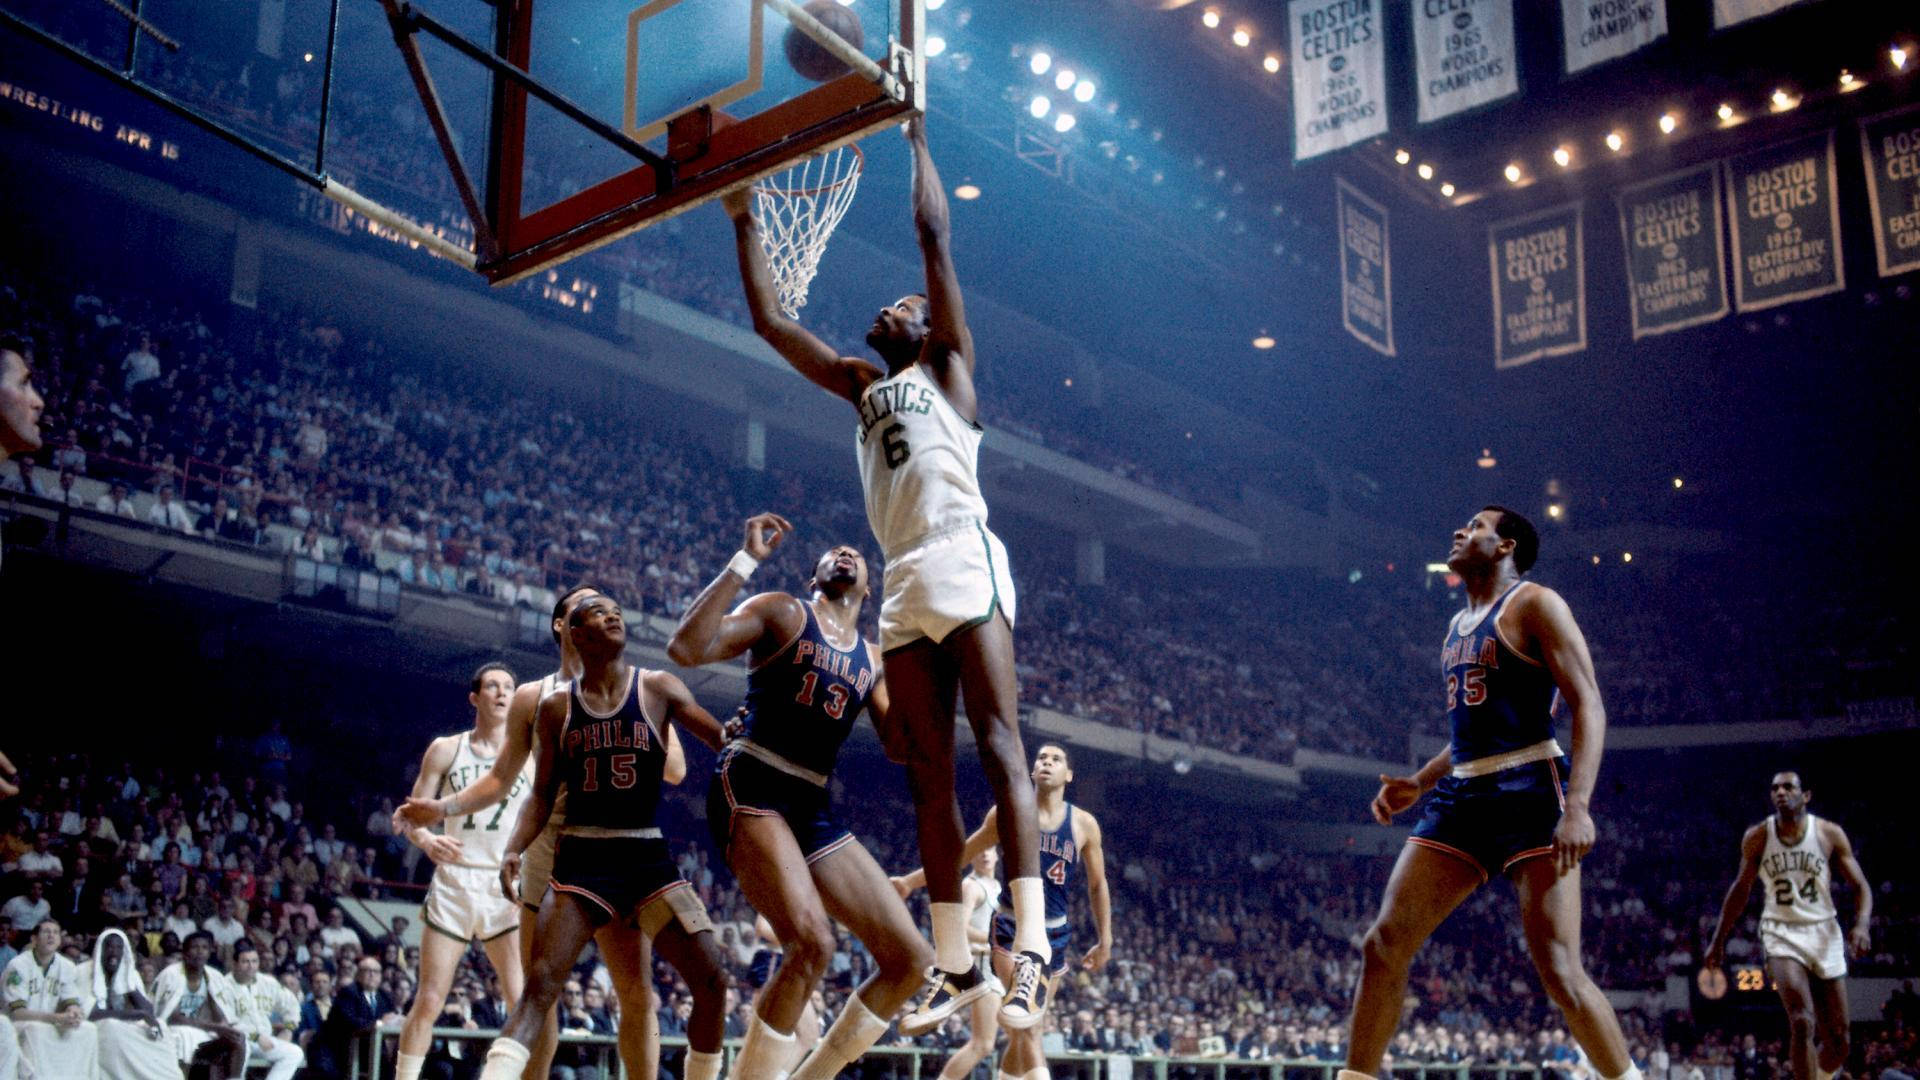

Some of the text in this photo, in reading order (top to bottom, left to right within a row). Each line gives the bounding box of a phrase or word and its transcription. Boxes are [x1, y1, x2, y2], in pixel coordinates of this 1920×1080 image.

[1303, 17, 1372, 60] CELTICS
[1581, 1, 1655, 47] CHAMPIONS
[1429, 57, 1503, 97] CHAMPIONS
[1441, 46, 1489, 72] WORLD
[0, 81, 104, 132] WRESTLING
[116, 125, 151, 150] APR
[1307, 101, 1375, 137] CHAMPIONS
[1746, 157, 1816, 197] BOSTON
[1635, 191, 1700, 226] BOSTON
[1748, 180, 1818, 219] CELTICS
[1505, 227, 1567, 262] BOSTON
[1636, 212, 1700, 248] CELTICS
[1507, 249, 1568, 282] CELTICS
[1747, 245, 1801, 272] EASTERN
[1753, 256, 1822, 287] CHAMPIONS
[881, 422, 911, 470] 6
[793, 639, 872, 701] PHILA
[795, 670, 850, 720] 13
[1446, 668, 1488, 712] 25
[567, 719, 650, 758] PHILA
[583, 753, 637, 792] 15
[1762, 850, 1825, 879] CELTICS
[1774, 877, 1819, 906] 24
